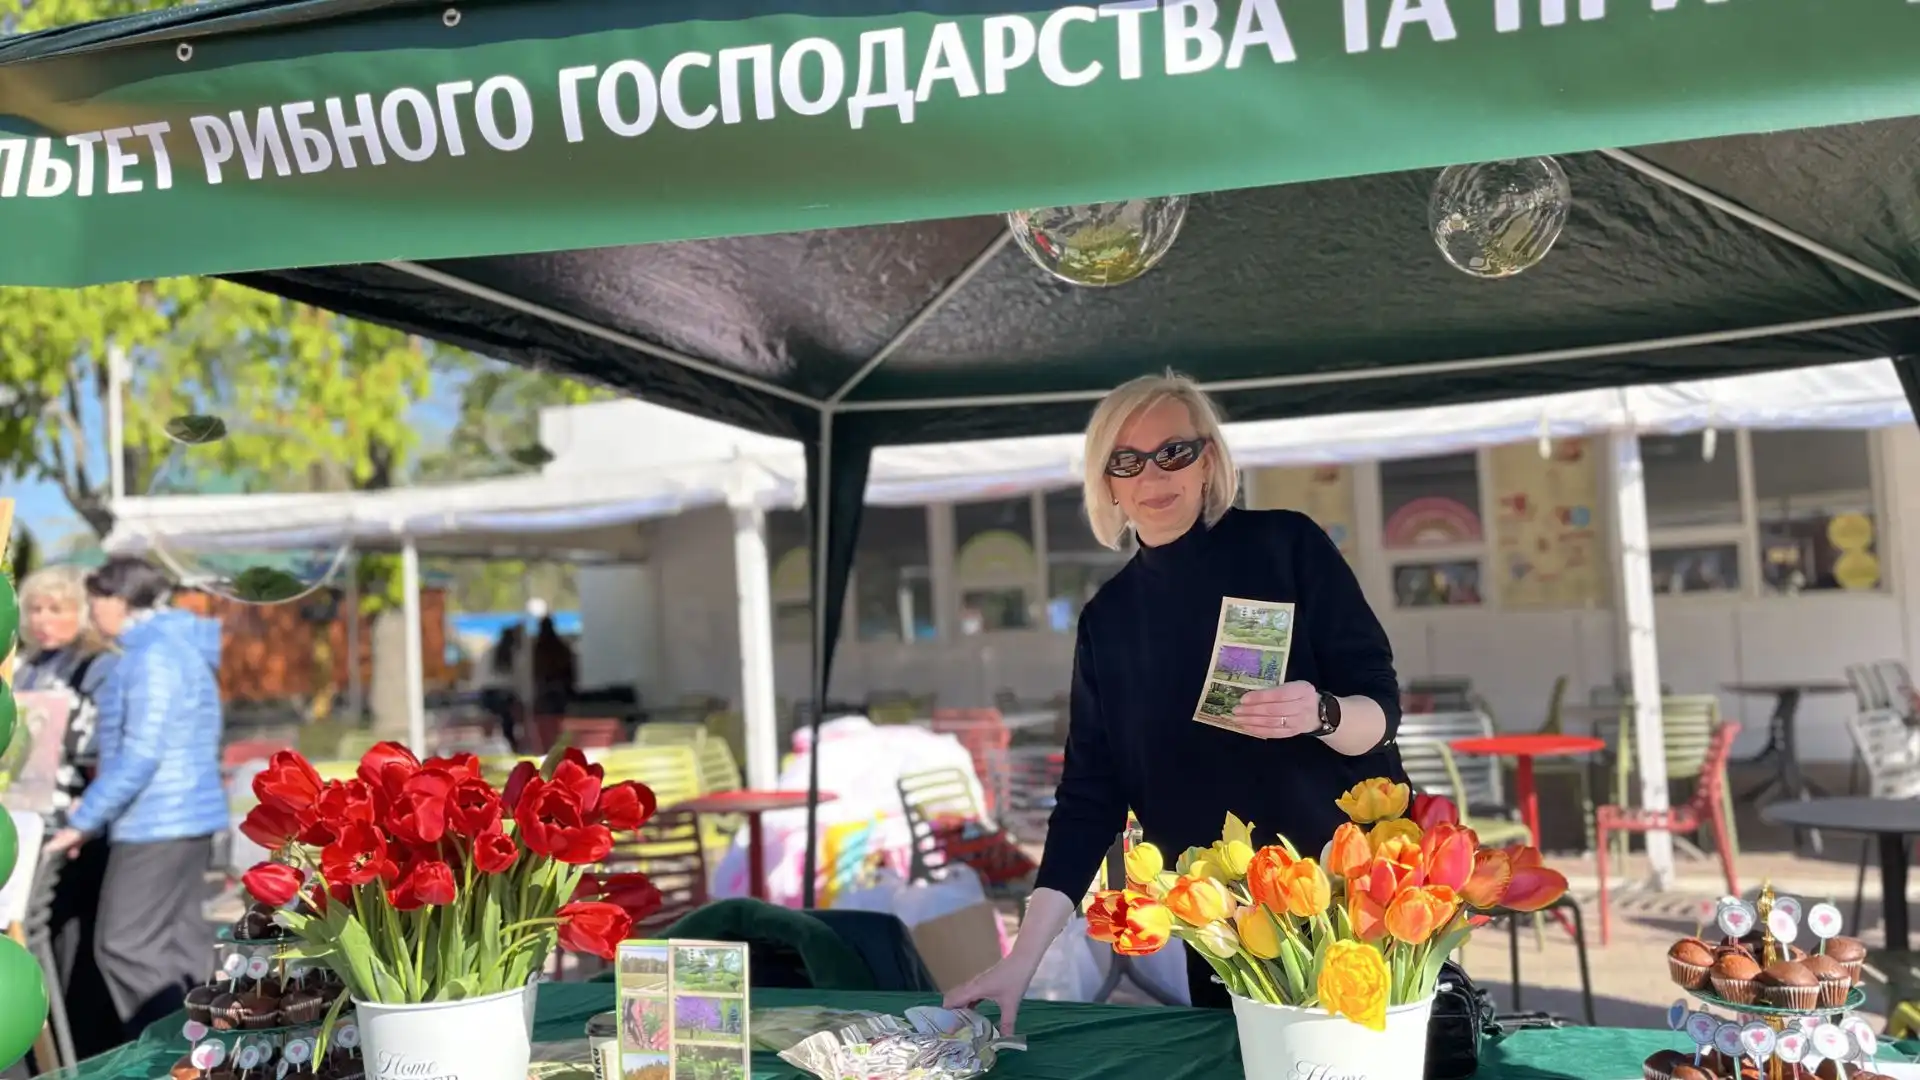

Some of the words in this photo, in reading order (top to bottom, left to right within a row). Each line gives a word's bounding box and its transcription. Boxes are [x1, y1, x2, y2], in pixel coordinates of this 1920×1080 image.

[190, 75, 534, 185] РИБНОГО
[558, 0, 1299, 142] ГОСПОДАРСТВА
[378, 1050, 439, 1075] Home
